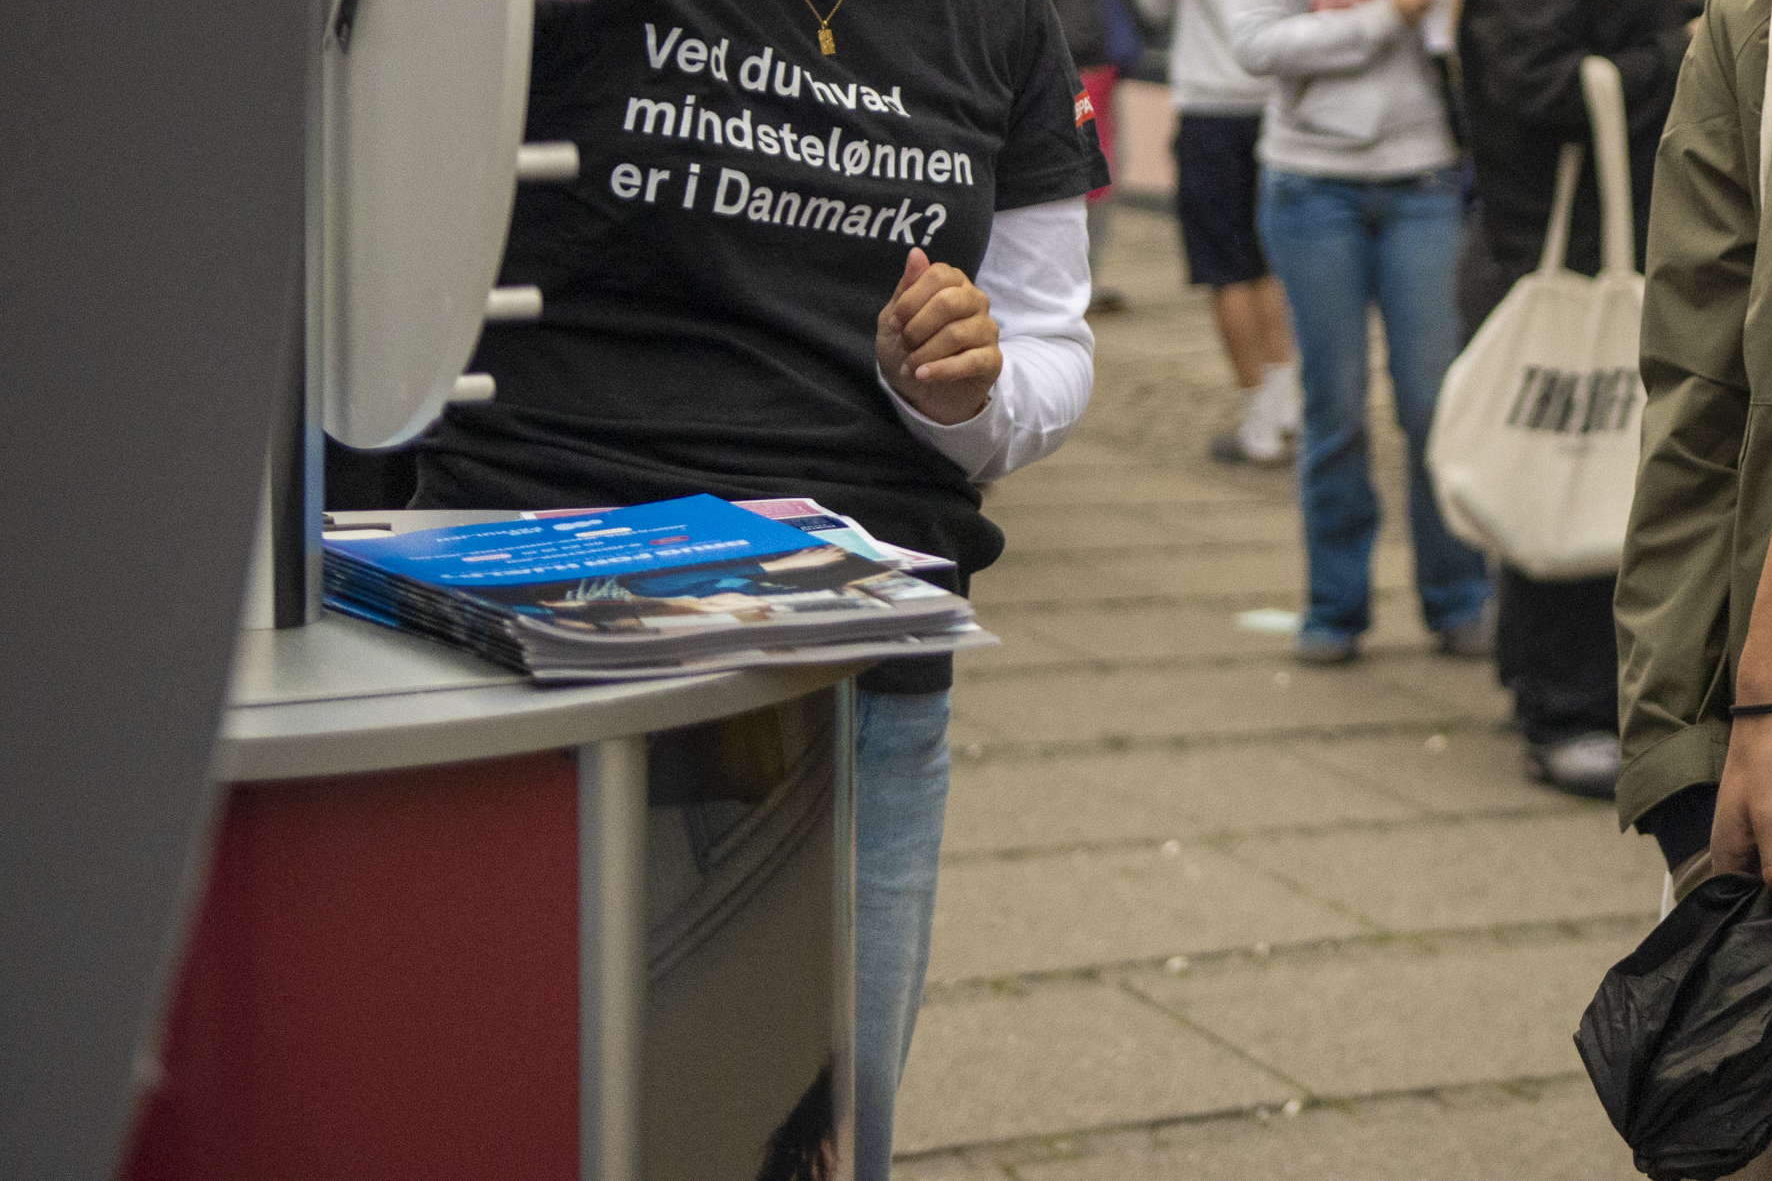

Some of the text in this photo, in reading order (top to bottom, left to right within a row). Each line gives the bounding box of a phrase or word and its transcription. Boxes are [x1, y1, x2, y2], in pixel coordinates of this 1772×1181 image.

[644, 22, 911, 118] Ved du hvad
[623, 94, 974, 186] mindstelønnen
[610, 162, 947, 246] er i Danmark?
